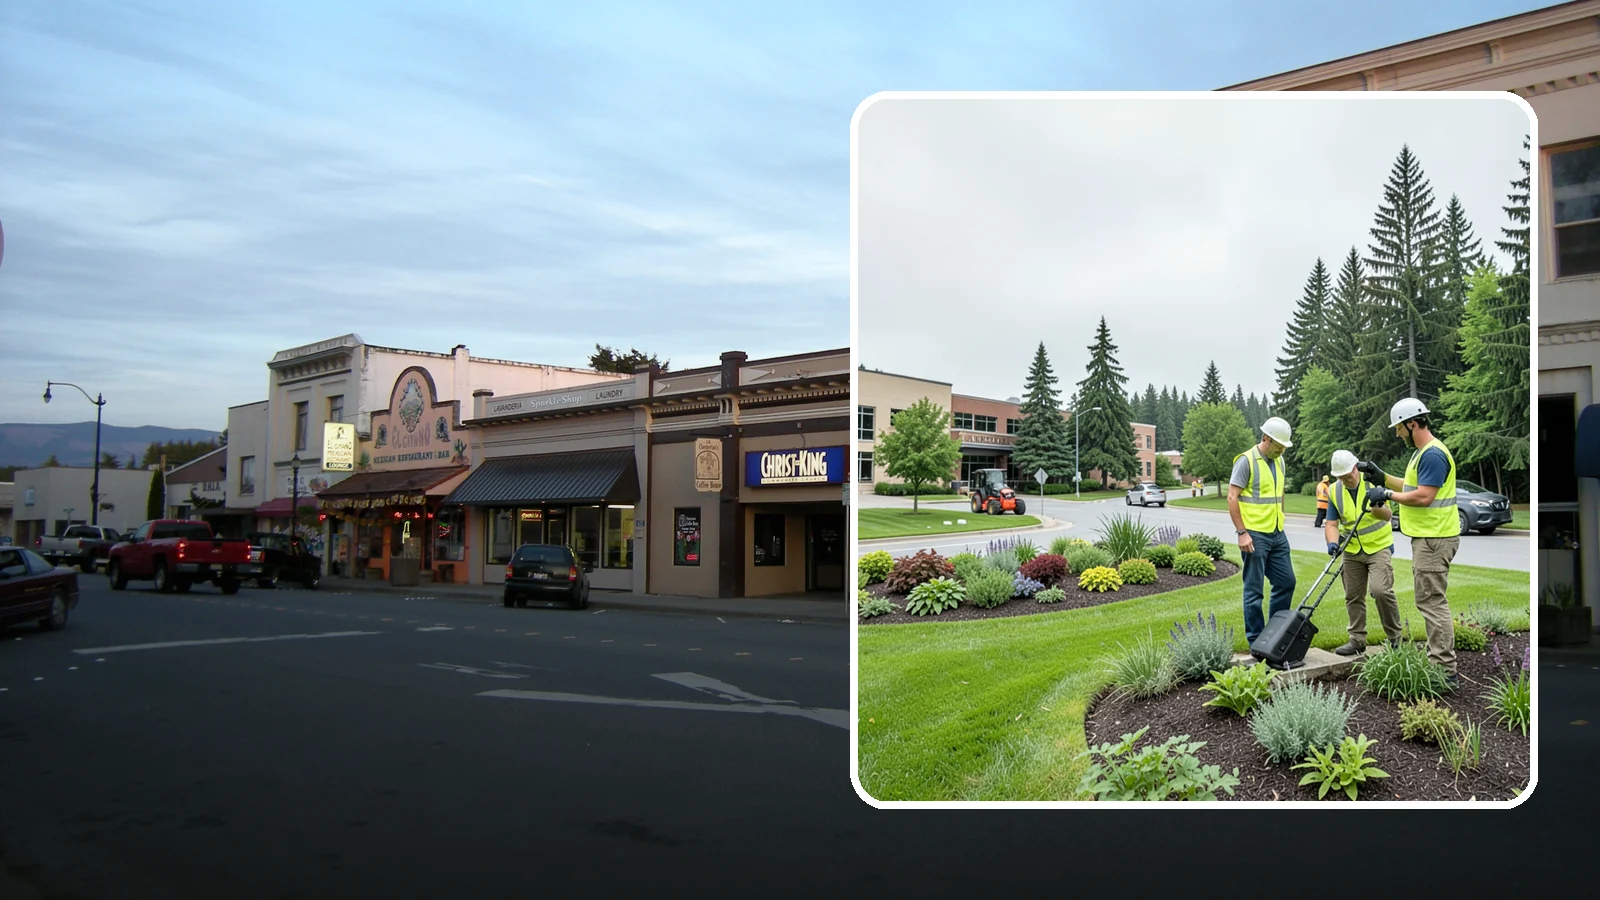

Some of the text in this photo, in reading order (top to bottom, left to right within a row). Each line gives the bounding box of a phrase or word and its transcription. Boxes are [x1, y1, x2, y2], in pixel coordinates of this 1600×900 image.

[493, 401, 523, 413] LAVANDERIA
[561, 394, 583, 404] Shop
[595, 389, 624, 400] LAUNDRY
[373, 454, 397, 464] MEXICAN
[397, 451, 433, 462] RESTAURANT
[437, 450, 450, 459] BAR
[761, 450, 827, 478] CHRIST KING
